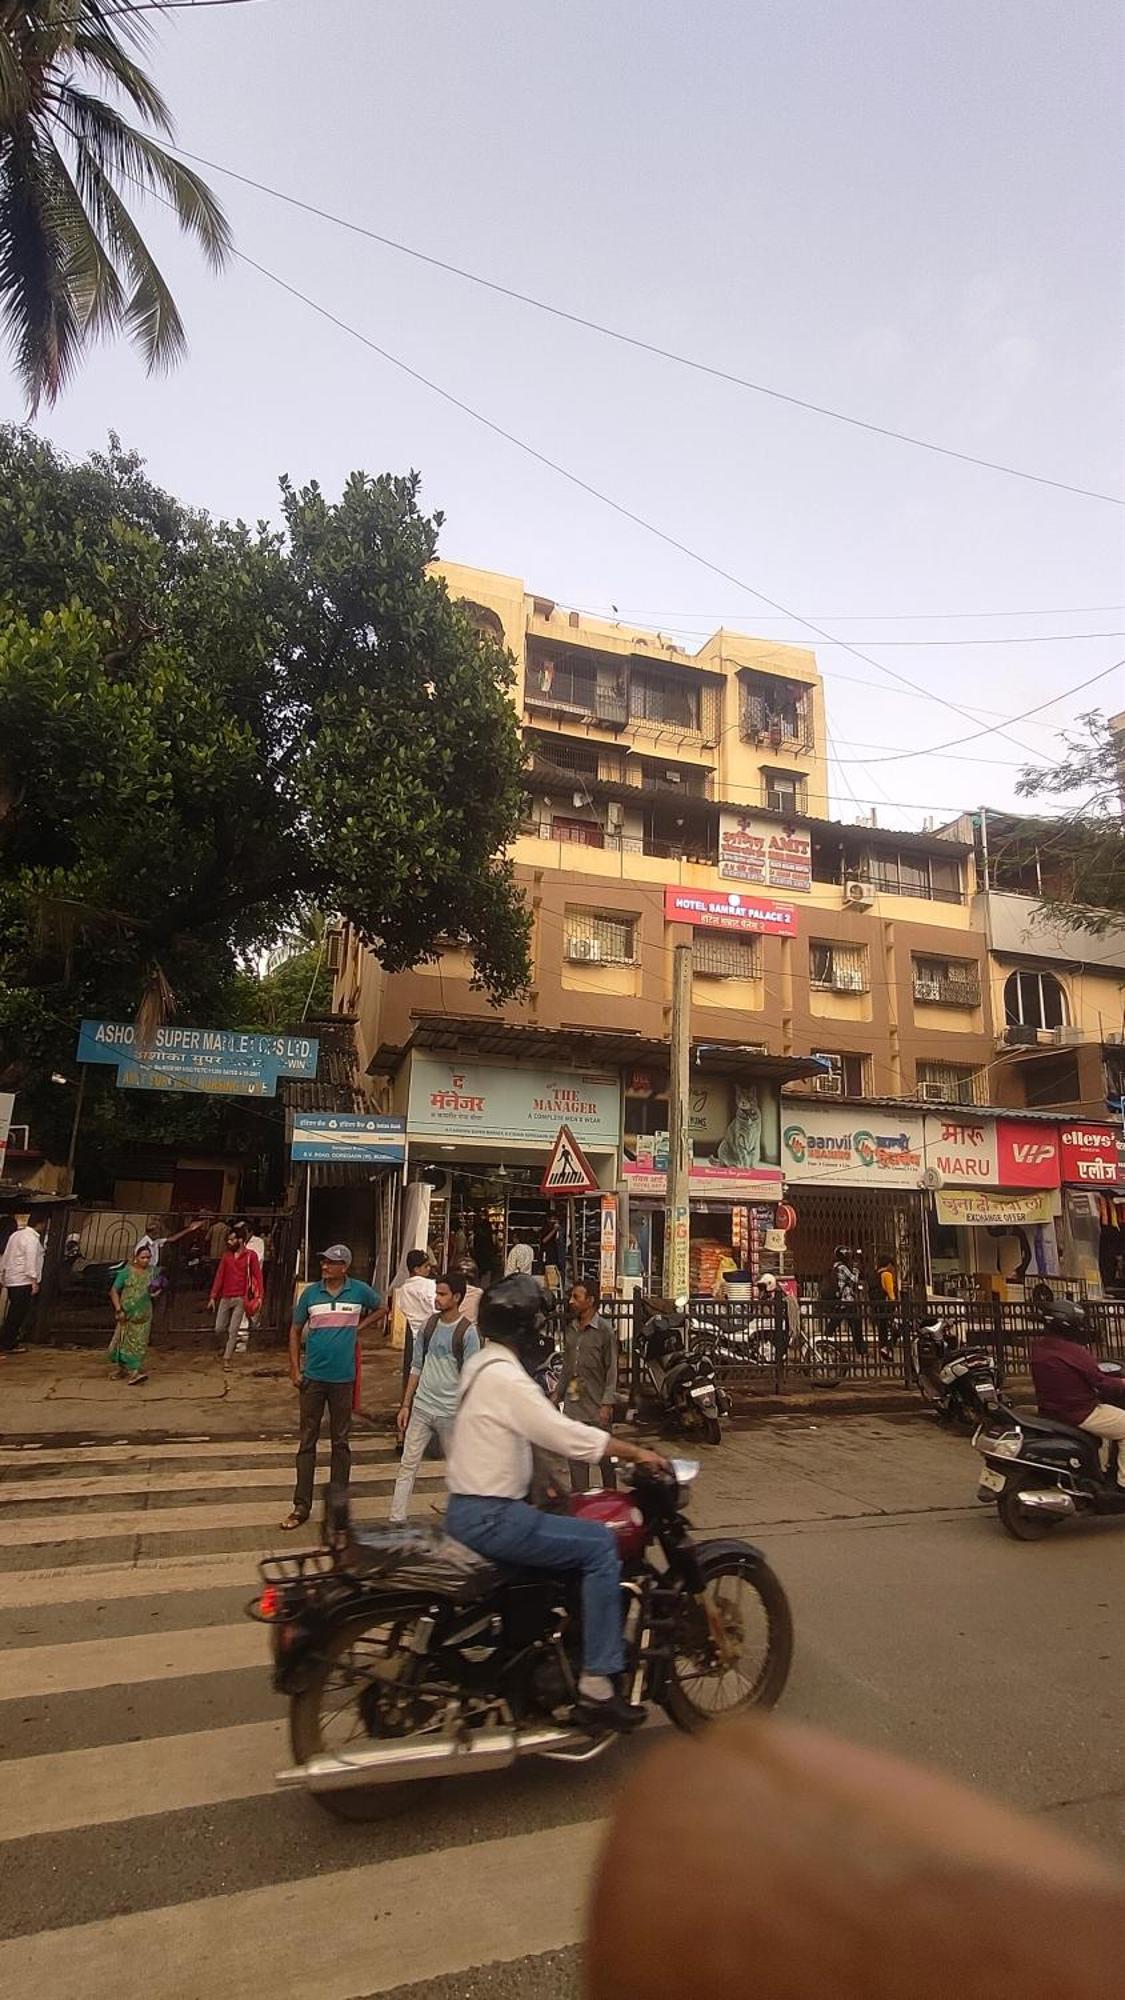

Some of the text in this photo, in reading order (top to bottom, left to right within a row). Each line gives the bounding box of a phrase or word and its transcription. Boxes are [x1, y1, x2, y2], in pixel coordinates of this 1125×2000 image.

[675, 899, 791, 923] HOTEL SAMRAT PALACE 2
[95, 1024, 136, 1044] ASHO
[156, 1028, 200, 1050] SUPER
[453, 1075, 464, 1089] द
[430, 1090, 486, 1112] मॅनेजर
[551, 1087, 579, 1101] THE
[532, 1098, 597, 1115] MANAGER
[1012, 1143, 1055, 1164] VIP
[937, 1157, 990, 1176] MARU
[1077, 1157, 1116, 1180] एलीज
[967, 1213, 1025, 1221] EXCHANGE OFFER
